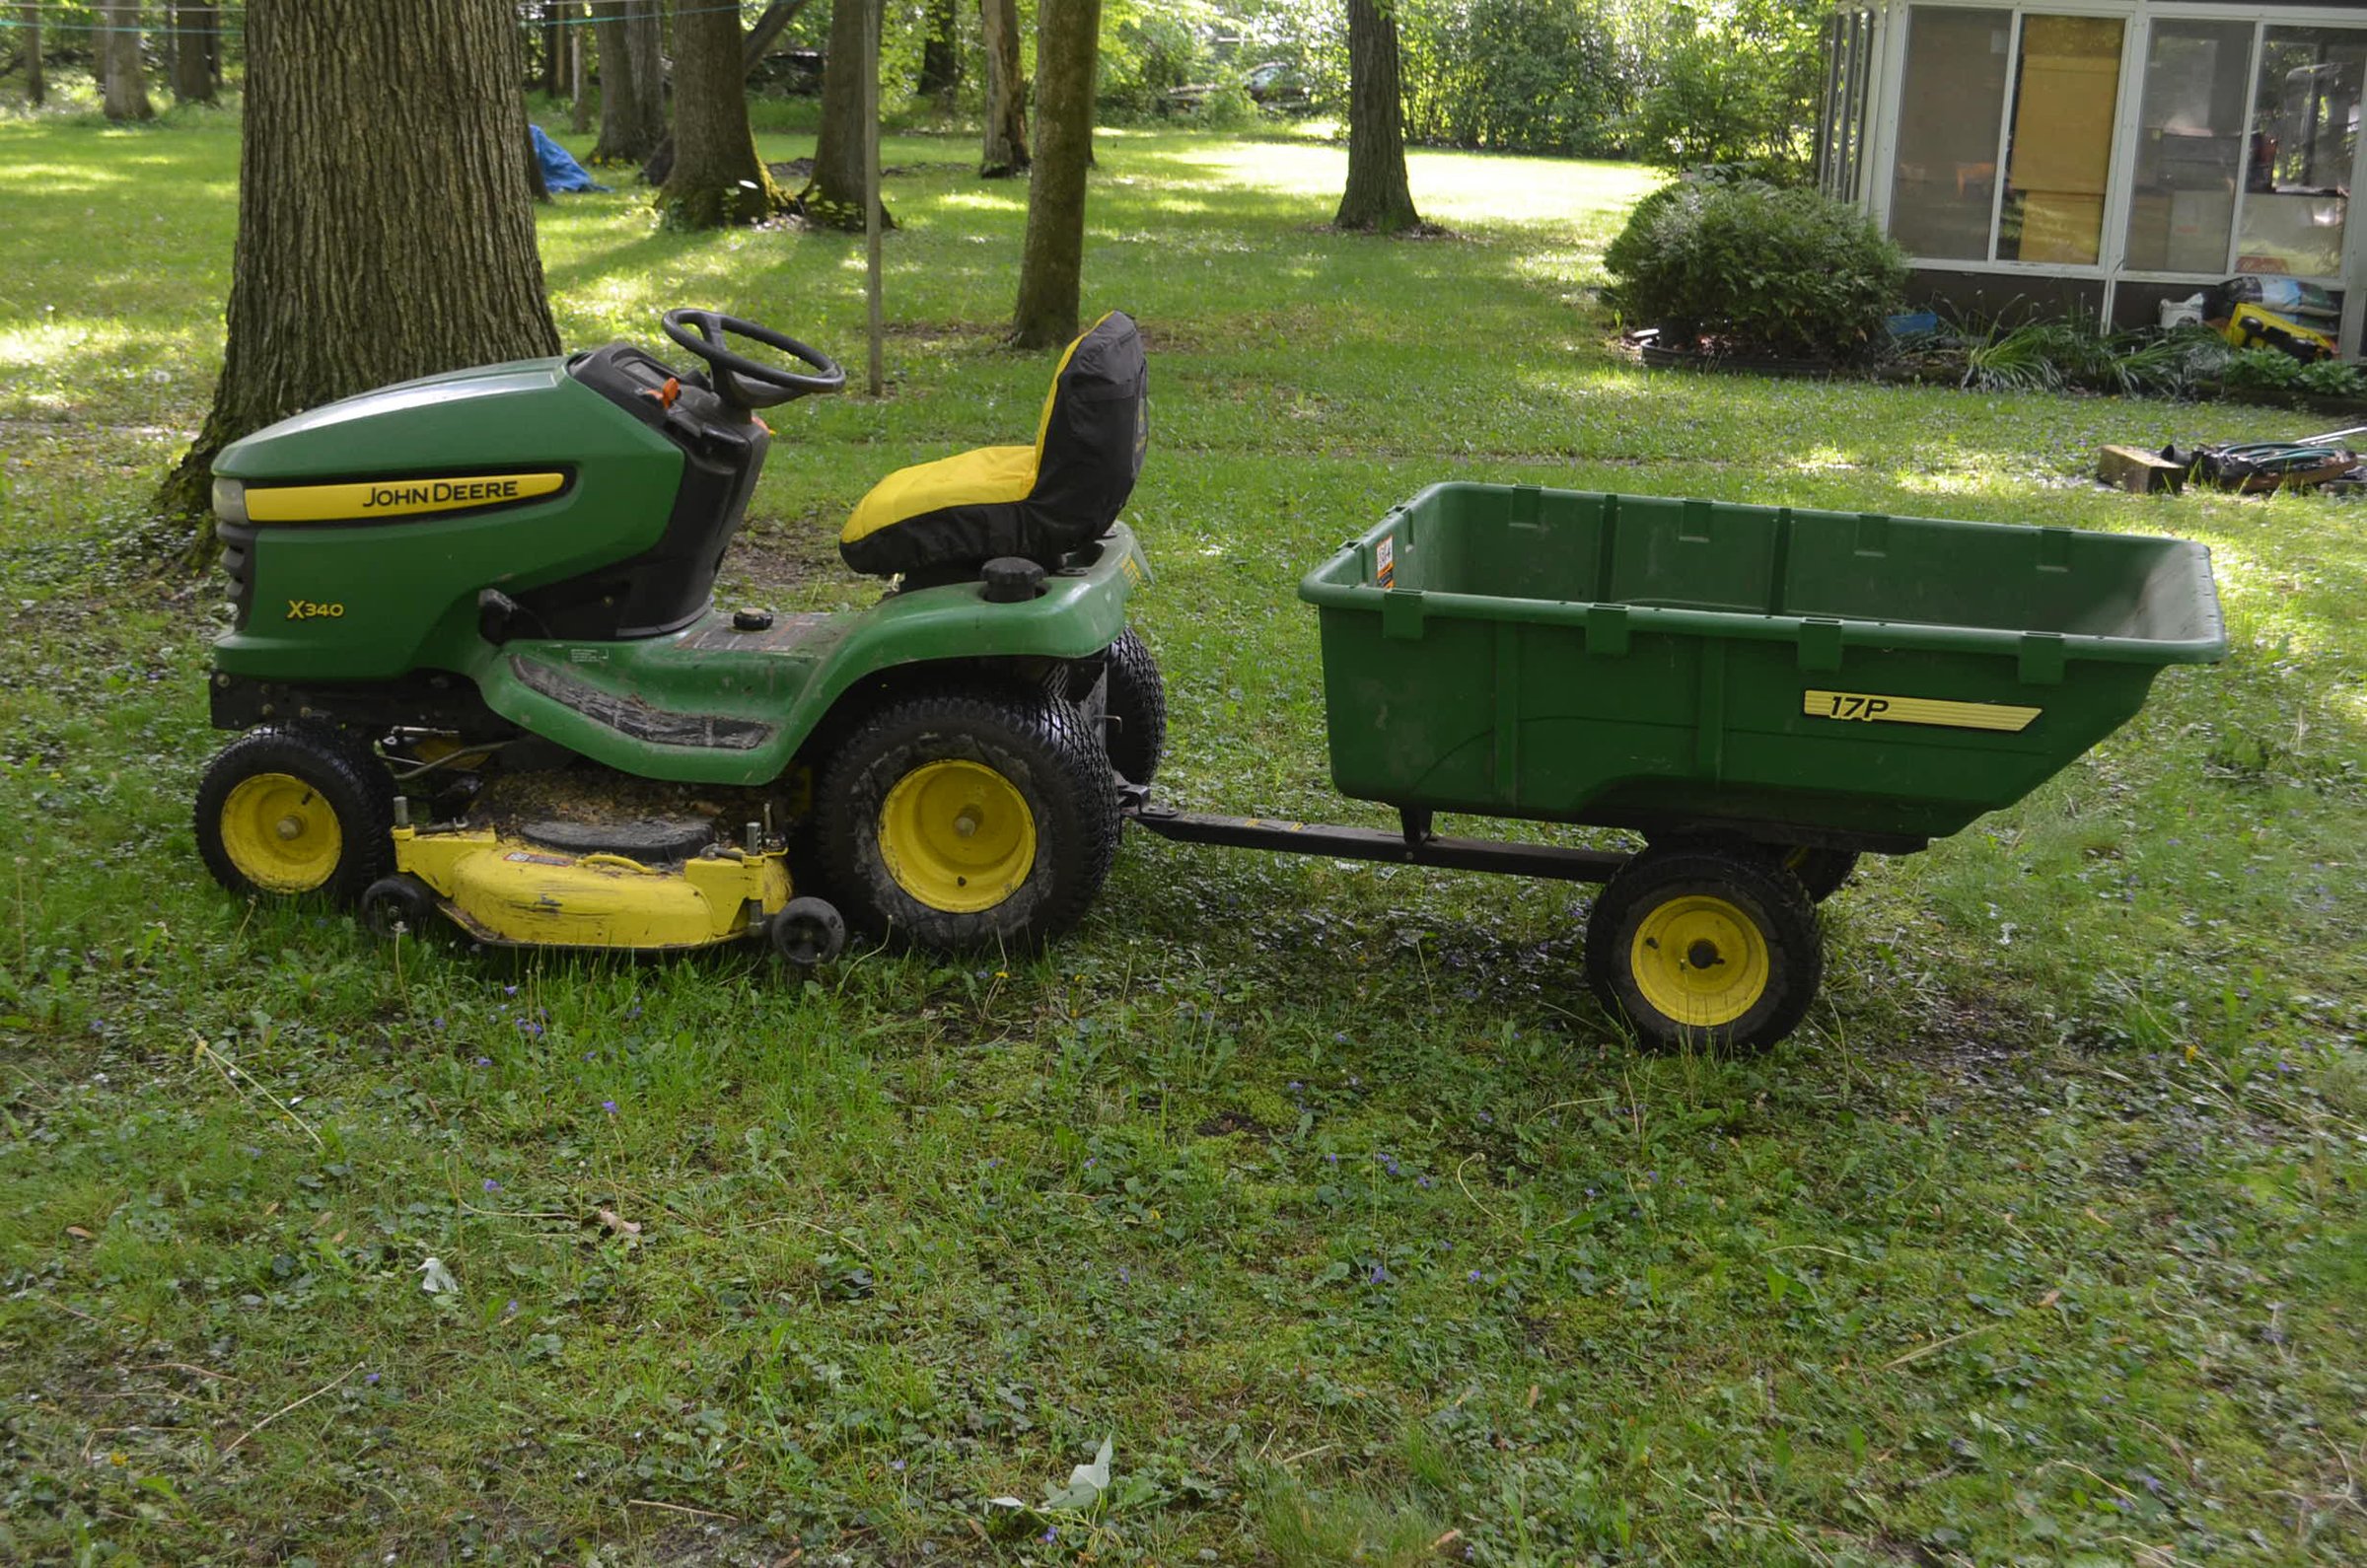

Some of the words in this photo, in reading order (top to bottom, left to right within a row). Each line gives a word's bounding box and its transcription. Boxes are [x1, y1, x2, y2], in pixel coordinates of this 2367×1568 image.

[363, 488, 428, 507] JOHN
[433, 481, 518, 502] DEERE
[287, 600, 344, 619] X340
[1830, 696, 1890, 719] 17P
